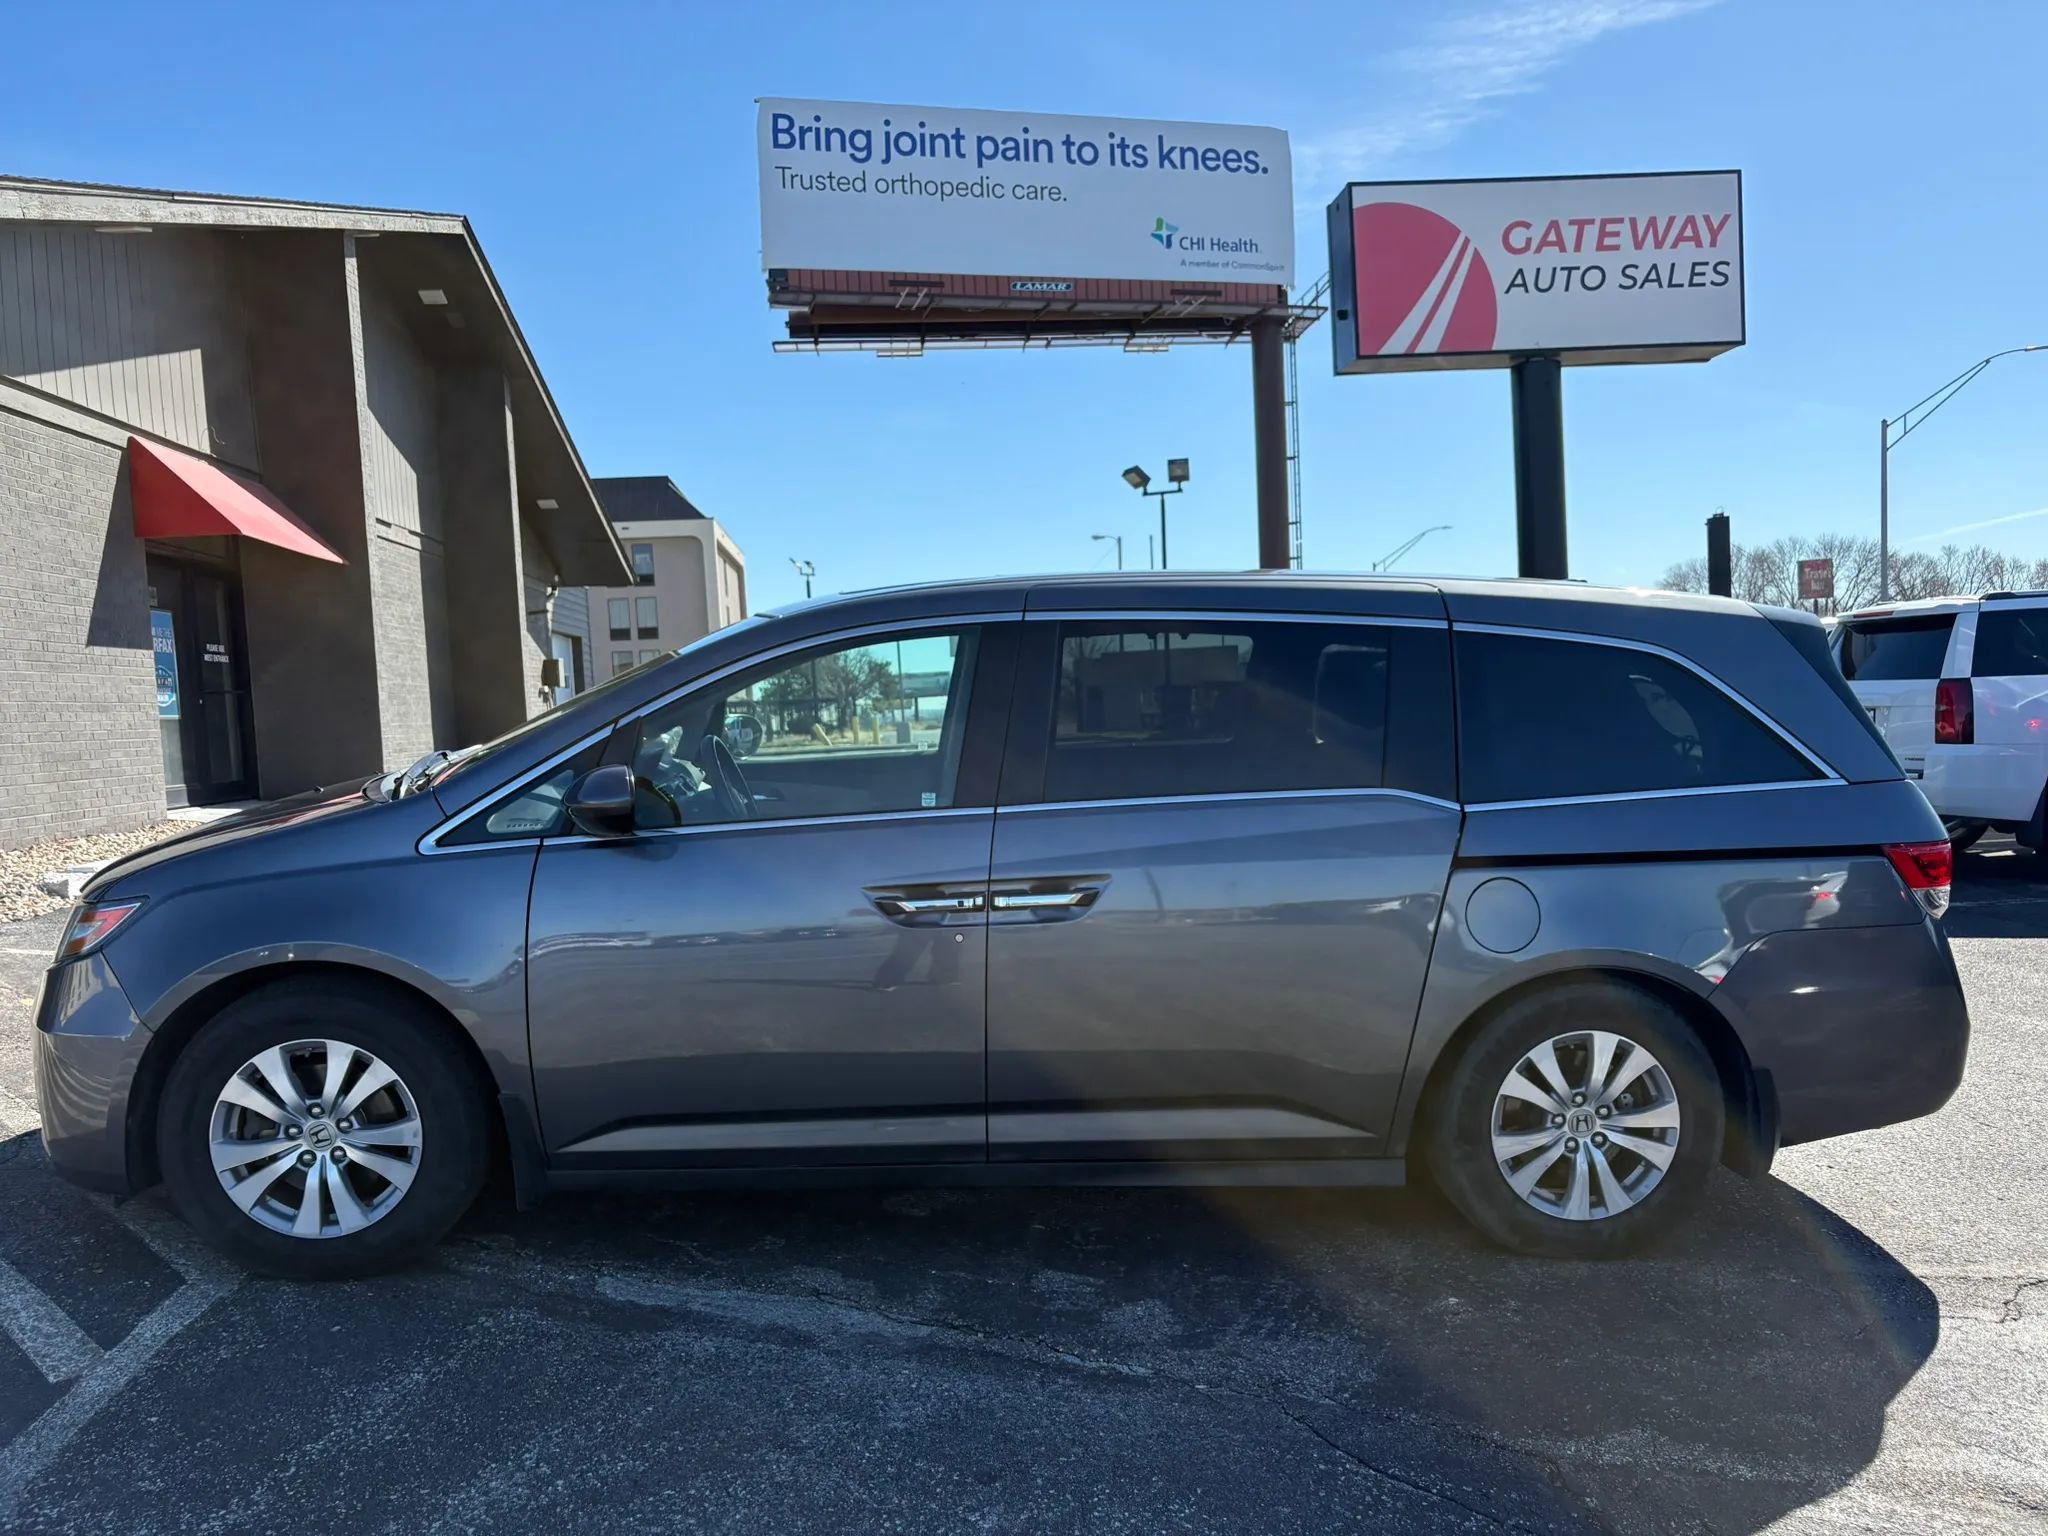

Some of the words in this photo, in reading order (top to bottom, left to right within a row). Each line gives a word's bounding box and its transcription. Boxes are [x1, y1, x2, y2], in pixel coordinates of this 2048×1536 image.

[772, 112, 873, 164] Bring
[881, 118, 967, 165] joint
[976, 126, 1054, 169] pain
[1061, 133, 1100, 166] to
[1108, 131, 1149, 169] its
[1157, 134, 1269, 175] knees.
[774, 165, 867, 194] Trusted
[874, 171, 1005, 202] orthopedic
[1011, 183, 1067, 202] care.
[1179, 236, 1205, 251] CHI
[1210, 237, 1260, 254] Health
[1501, 213, 1732, 256] GATEWAY
[1180, 259, 1187, 268] A
[1188, 260, 1220, 269] member
[1221, 260, 1230, 269] of
[1015, 282, 1067, 290] LAMAR
[1504, 264, 1607, 295] AUTO
[1617, 260, 1731, 290] SALES
[153, 638, 173, 654] RFAX
